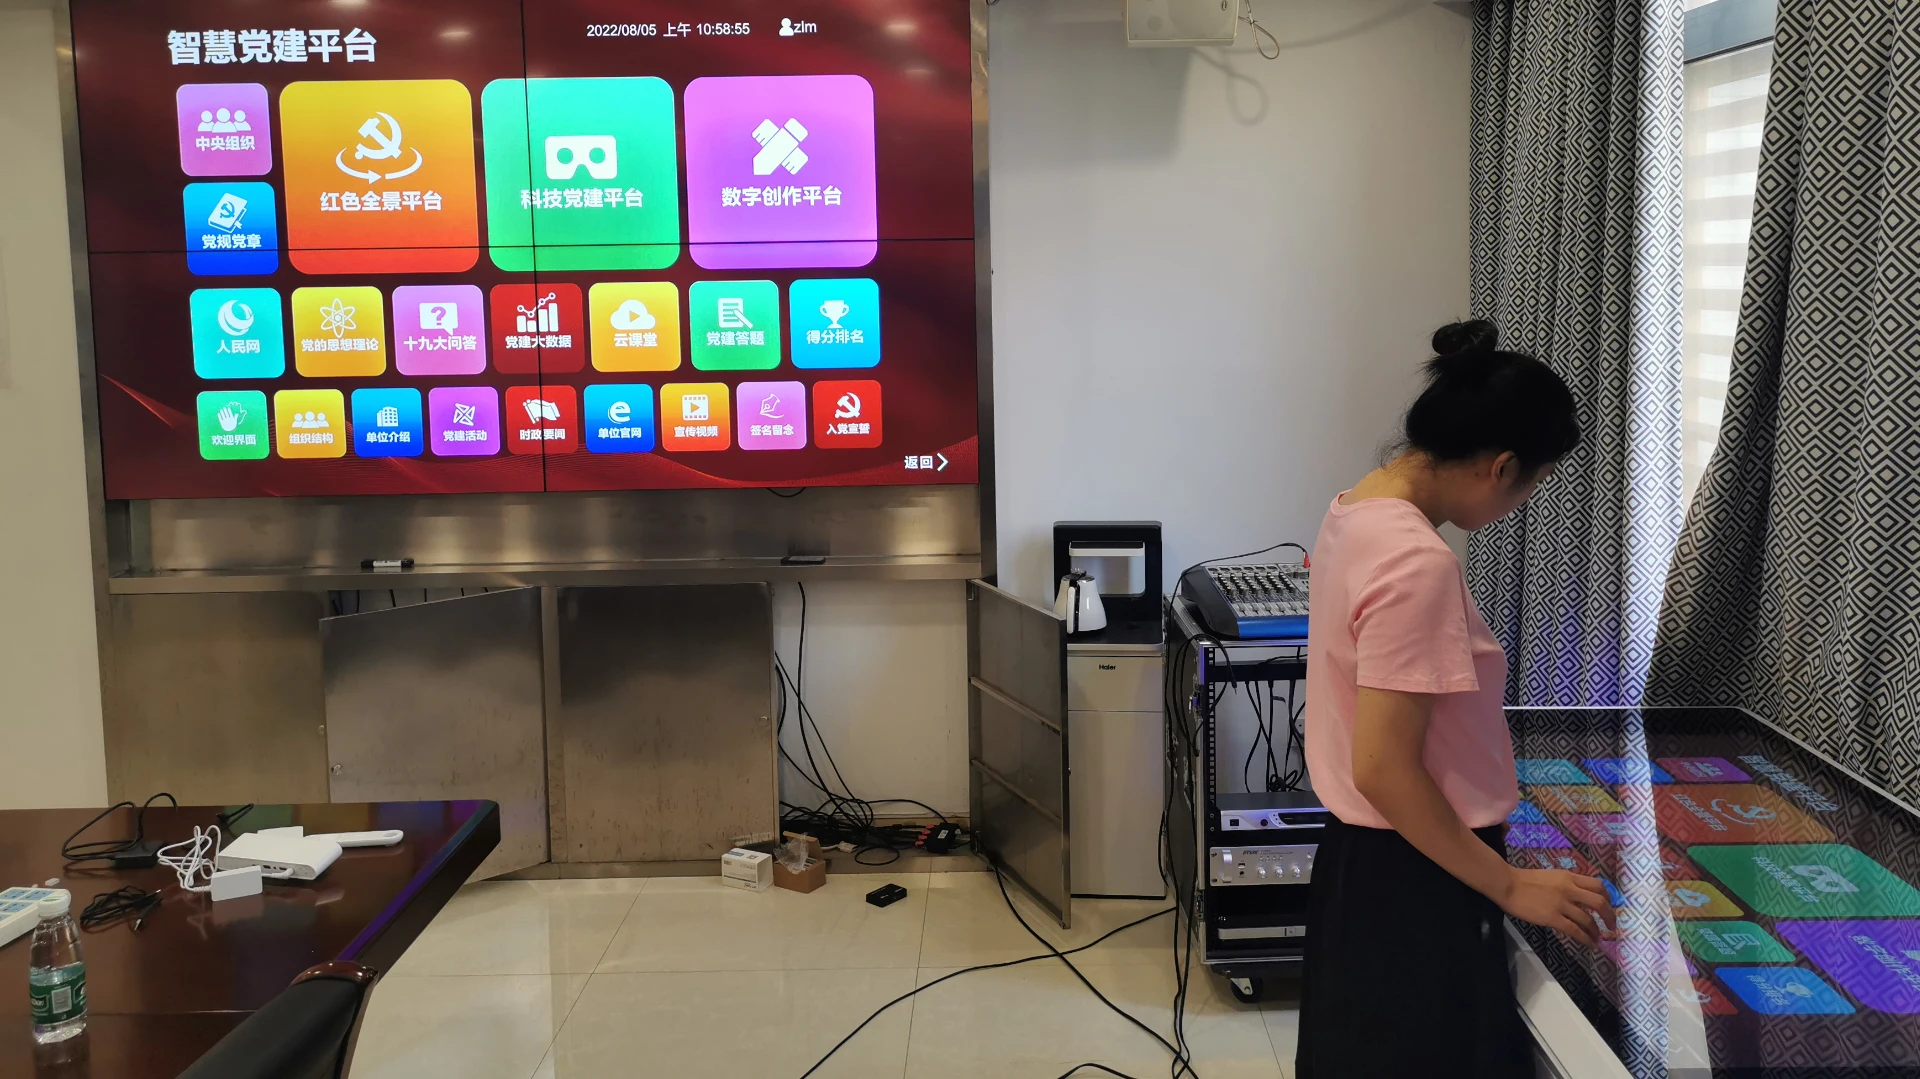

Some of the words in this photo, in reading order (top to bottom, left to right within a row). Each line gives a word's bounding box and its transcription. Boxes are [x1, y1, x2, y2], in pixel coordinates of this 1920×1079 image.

[586, 23, 657, 37] 2022/08/05
[662, 21, 692, 38] 上午
[696, 22, 751, 36] 10:58:55
[794, 20, 817, 34] zlm
[167, 27, 377, 66] 智慧党建平台
[195, 135, 256, 152] 中央组织
[319, 190, 443, 212] 红色全景平台
[520, 187, 644, 210] 科技党建平台
[721, 186, 843, 207] 数字创作平台
[201, 234, 262, 250] 党规党章
[404, 336, 478, 351] 十九大问答
[505, 335, 572, 349] 党建大数据
[613, 332, 658, 347] 云课堂
[706, 331, 765, 346] 党建答题
[806, 329, 864, 344] 得分排名
[216, 339, 261, 354] 人民网
[301, 338, 379, 352] 党的思想理论
[442, 429, 488, 442] 党建活动
[519, 428, 566, 441] 时政要闻
[597, 426, 642, 439] 单位官网
[674, 425, 719, 438] 宣传视频
[750, 423, 795, 436] 签名留念
[826, 422, 871, 435] 入党宣誓
[211, 434, 257, 446] 欢迎界面
[288, 432, 334, 445] 组织结构
[365, 431, 411, 443] 单位介绍
[904, 455, 934, 470] 返回
[1098, 663, 1117, 671] Haier
